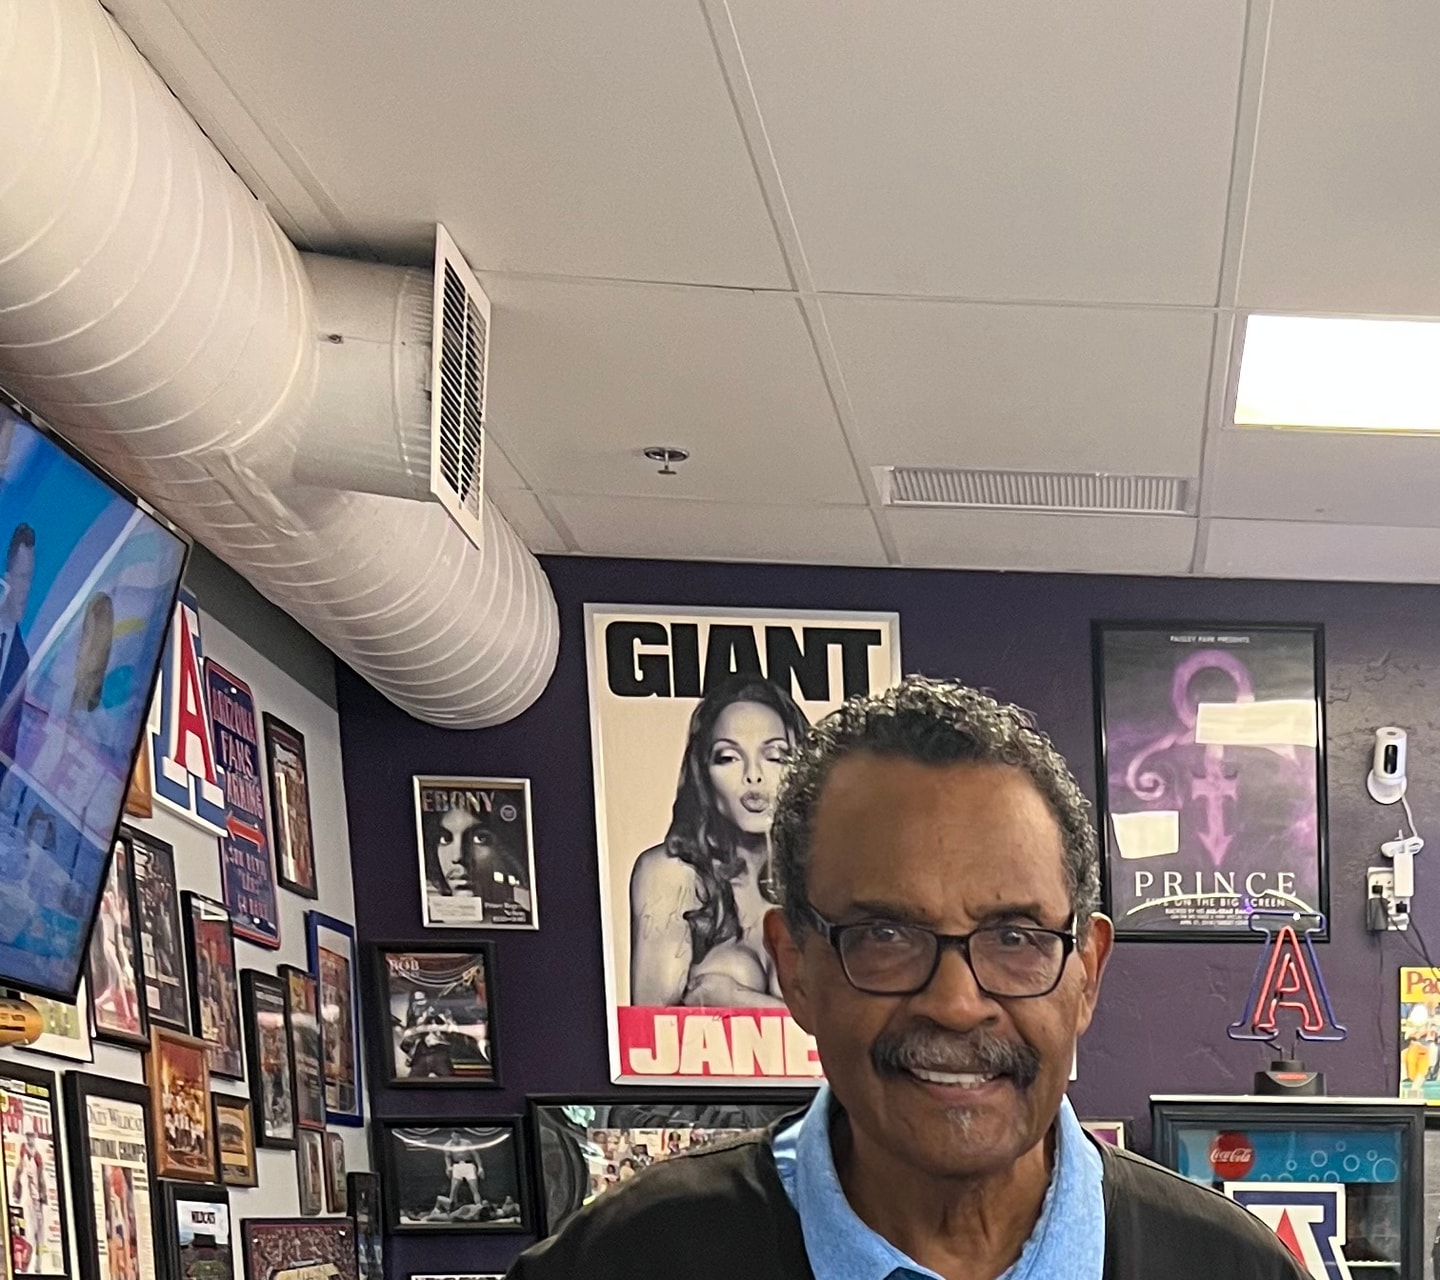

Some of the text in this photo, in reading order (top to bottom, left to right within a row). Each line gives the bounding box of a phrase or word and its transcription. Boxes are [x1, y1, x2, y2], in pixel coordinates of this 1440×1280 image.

[605, 620, 882, 701] GIANT
[225, 770, 263, 820] ARKING
[422, 790, 495, 812] EBONY
[1135, 871, 1297, 898] PRINCE
[1174, 899, 1192, 907] ON
[1200, 899, 1215, 907] THE
[1220, 899, 1239, 907] BIG
[1245, 899, 1286, 907] SCREEN
